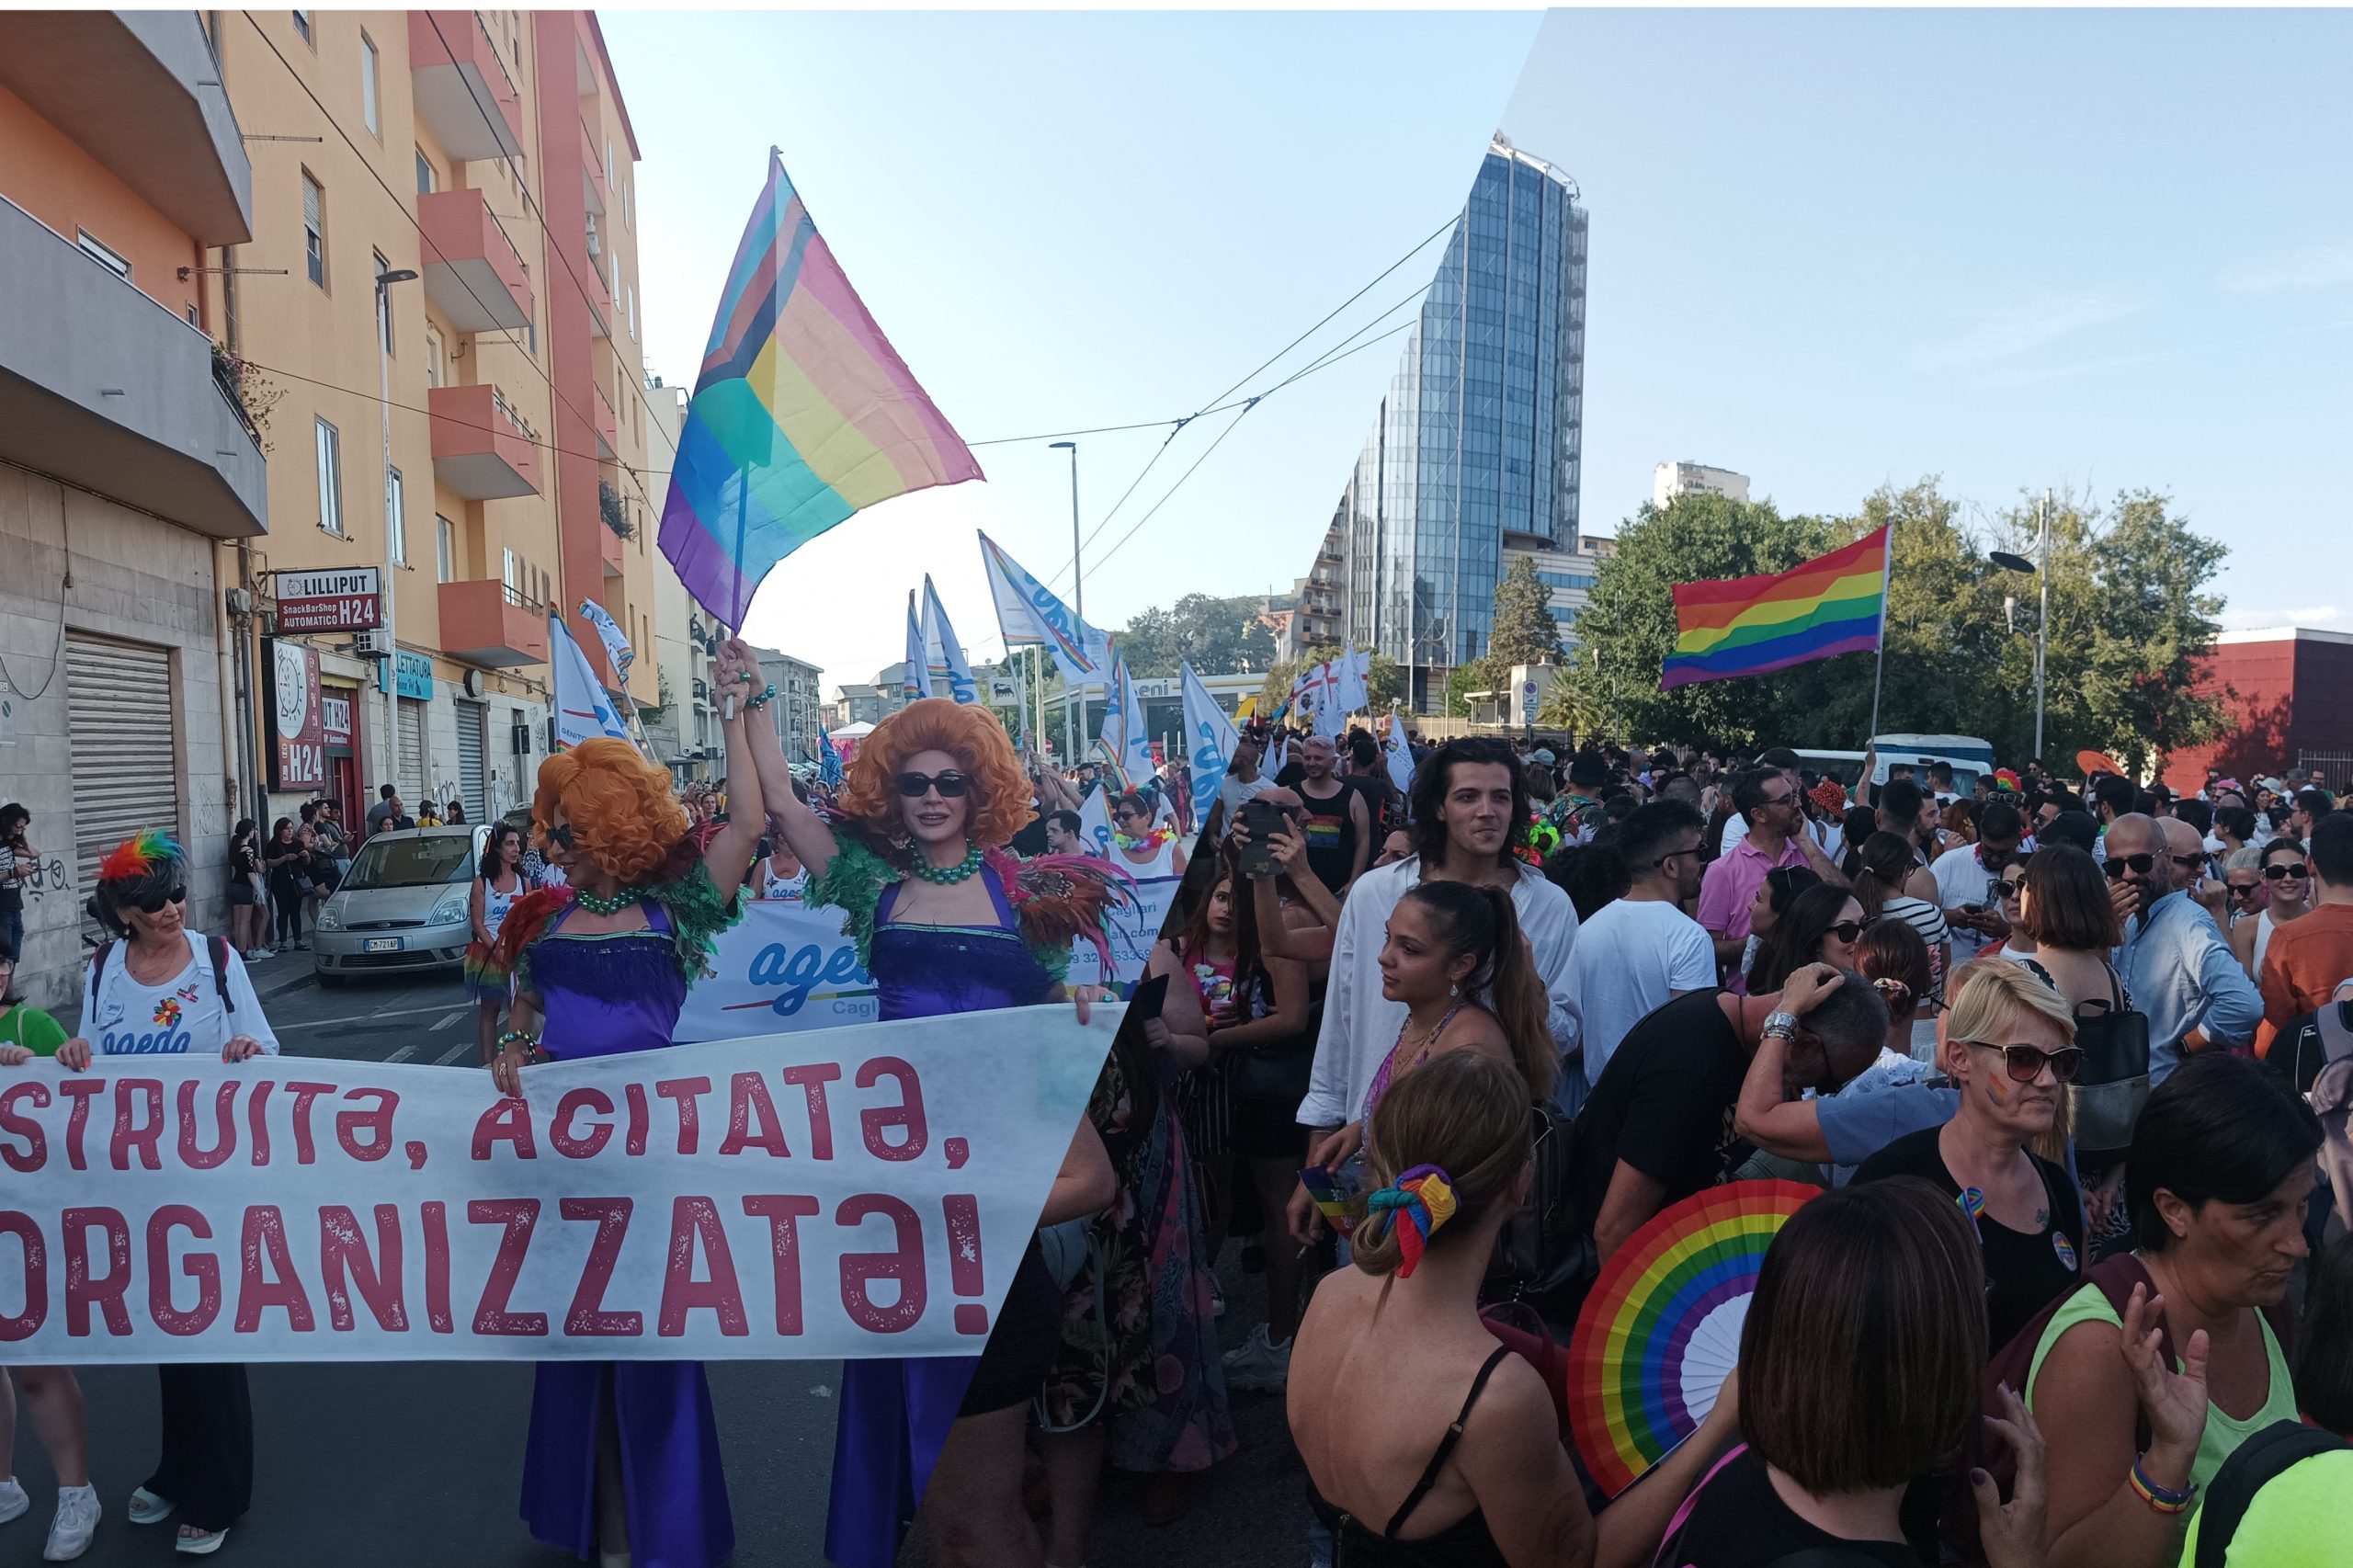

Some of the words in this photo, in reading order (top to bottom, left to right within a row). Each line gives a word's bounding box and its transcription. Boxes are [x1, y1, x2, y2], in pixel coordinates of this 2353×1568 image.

[304, 575, 367, 596] LILLIPUT
[283, 603, 336, 615] SnackBarShop
[339, 598, 374, 624] H24
[284, 615, 337, 628] AUTOMATICO
[1139, 679, 1169, 697] eni
[335, 702, 349, 729] H24
[290, 744, 323, 782] H24
